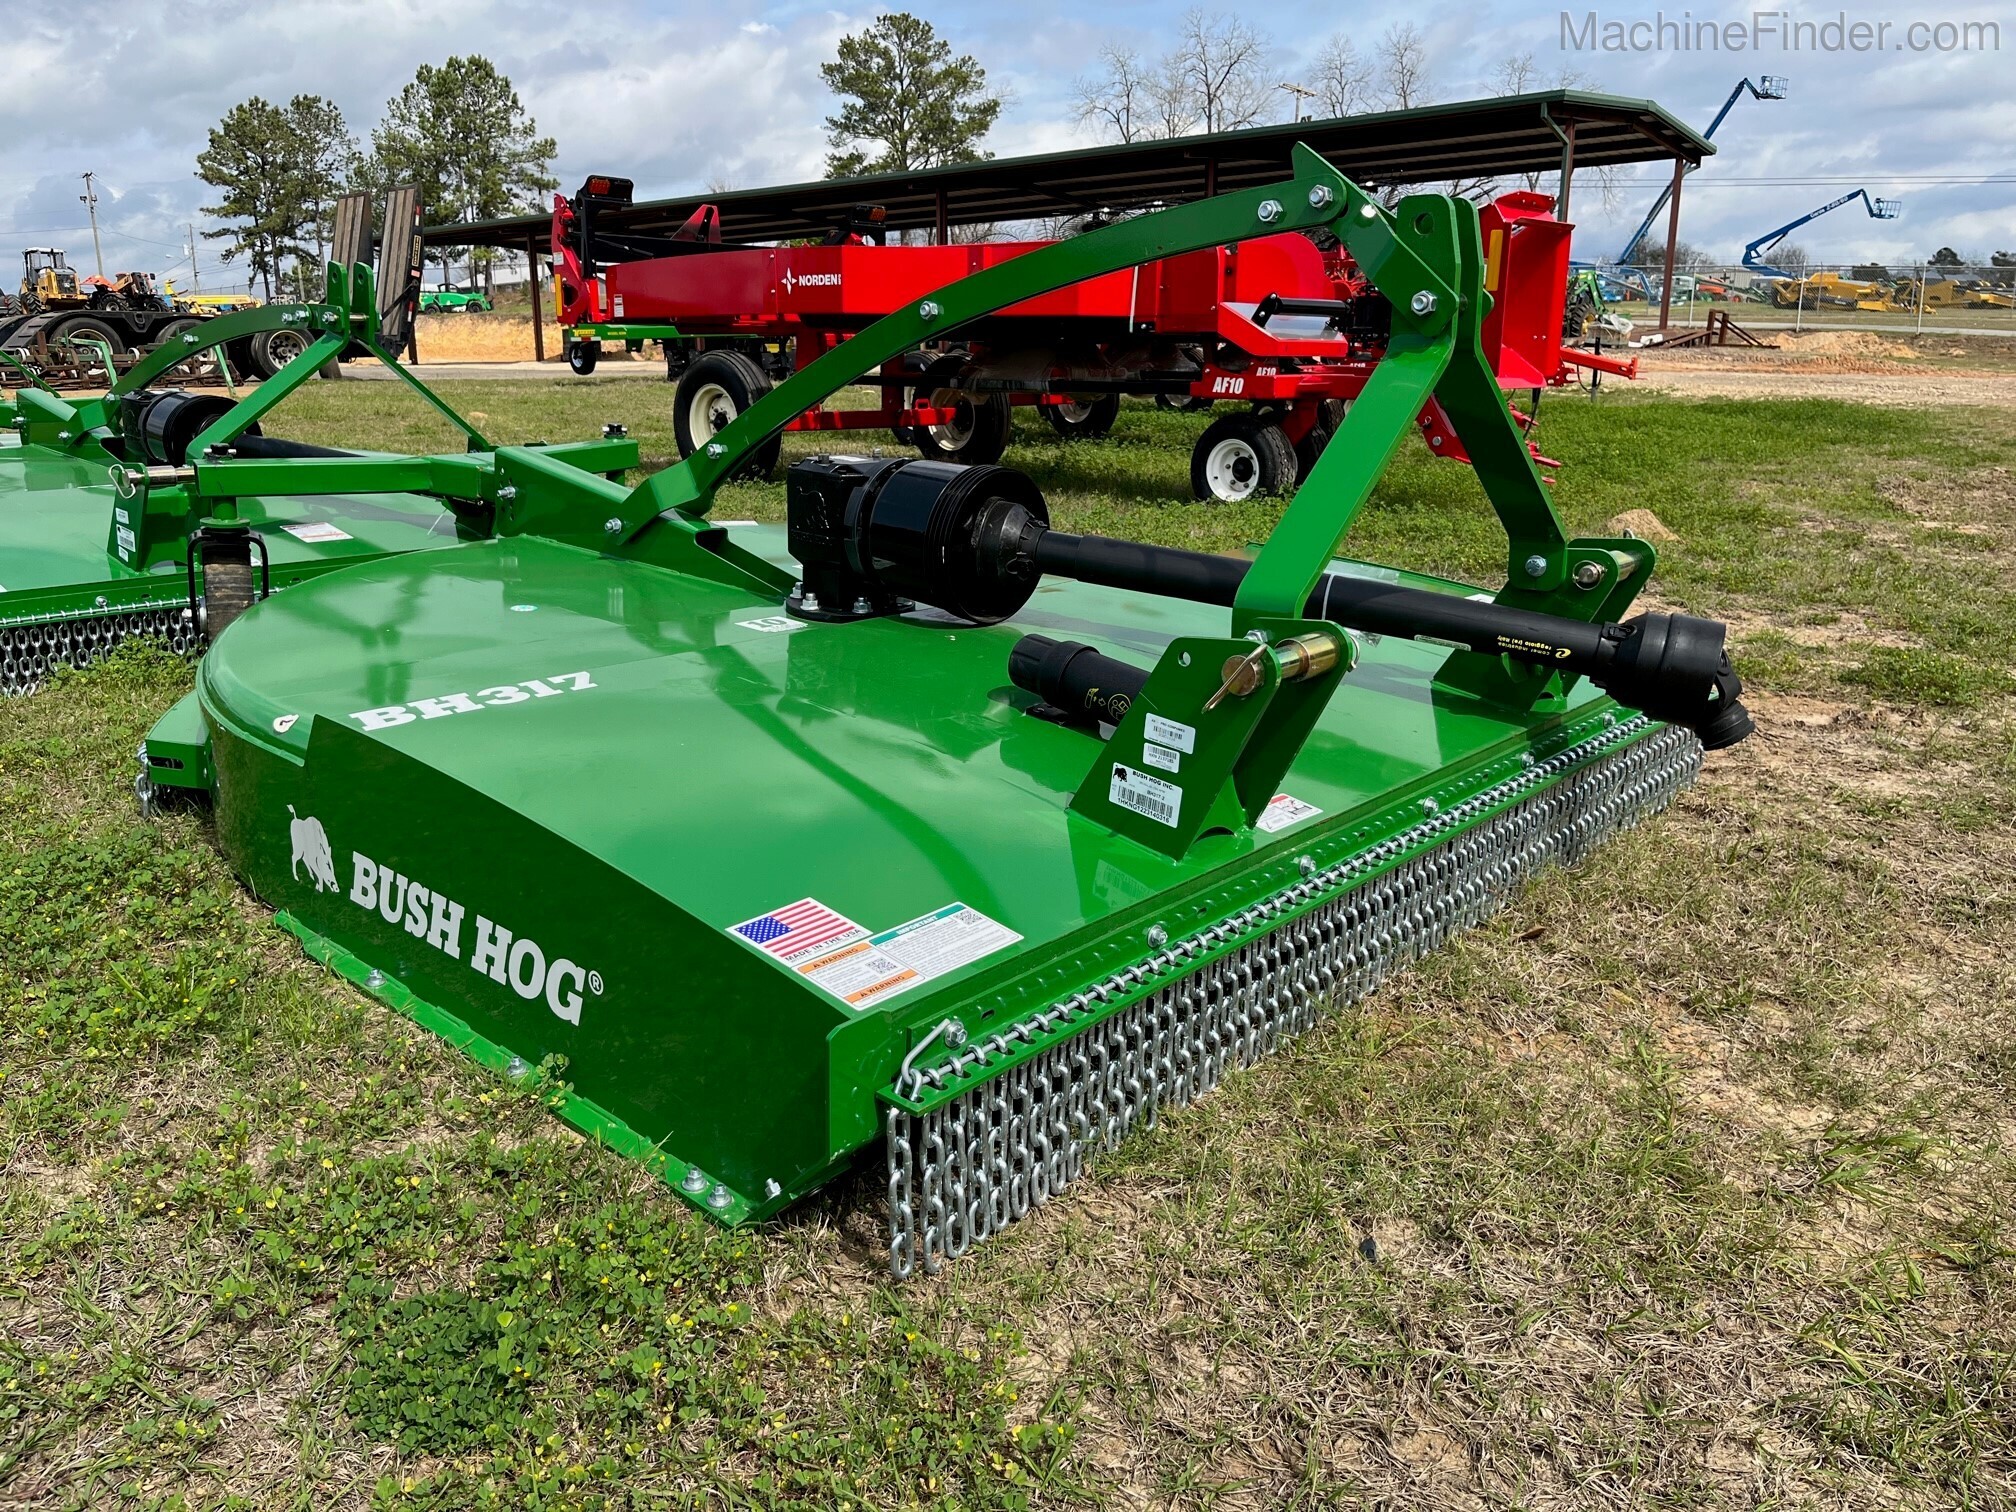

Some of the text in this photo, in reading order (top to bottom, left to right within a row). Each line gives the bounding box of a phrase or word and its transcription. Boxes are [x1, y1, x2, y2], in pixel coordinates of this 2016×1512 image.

[799, 274, 838, 286] NORDEN
[1212, 376, 1245, 394] AF10
[348, 671, 599, 732] BH317
[1132, 770, 1148, 780] BUSH
[1148, 777, 1162, 786] HOG
[349, 850, 465, 960] BUSH
[785, 947, 812, 962] MADE
[823, 936, 841, 946] THE
[842, 929, 860, 938] USA
[820, 948, 859, 965] WARNING
[869, 975, 905, 993] WARNING
